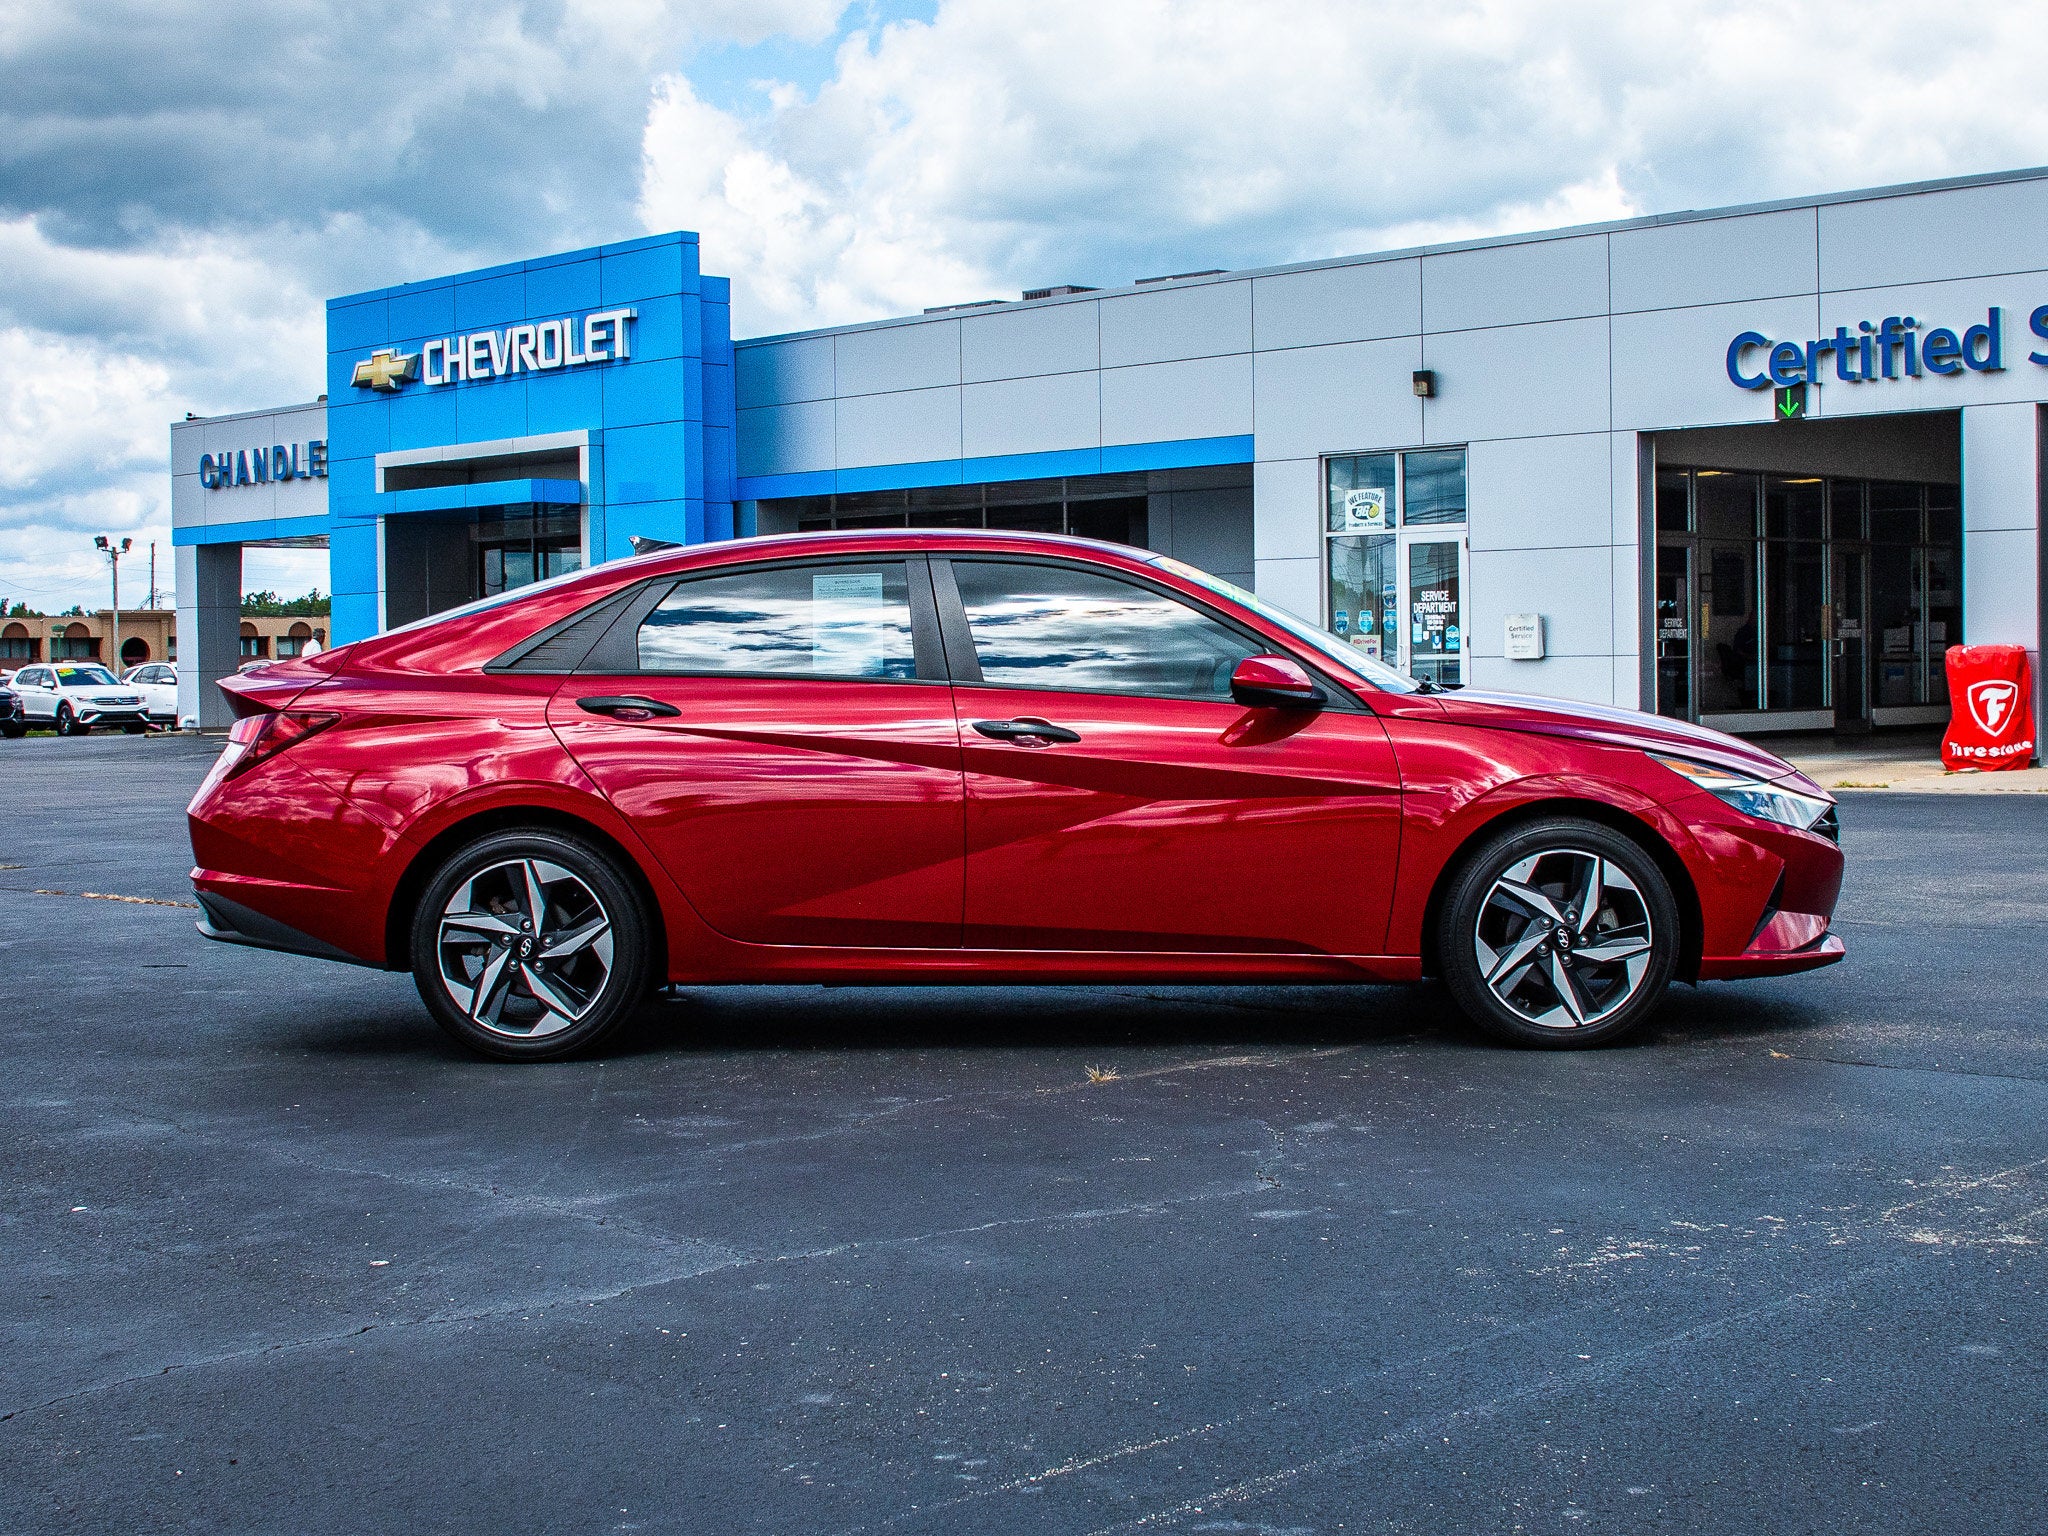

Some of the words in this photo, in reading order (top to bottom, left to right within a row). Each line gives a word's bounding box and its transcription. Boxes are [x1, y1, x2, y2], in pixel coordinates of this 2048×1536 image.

[423, 308, 637, 386] CHEVROLET
[1726, 306, 2002, 389] Certified
[200, 440, 329, 489] CHANDLE
[1358, 491, 1382, 503] FEATURE
[1421, 590, 1449, 601] SERVICE
[1413, 602, 1456, 613] DEPARTMENT
[1664, 618, 1683, 628] SERVICE
[1949, 740, 2033, 758] Firestone
